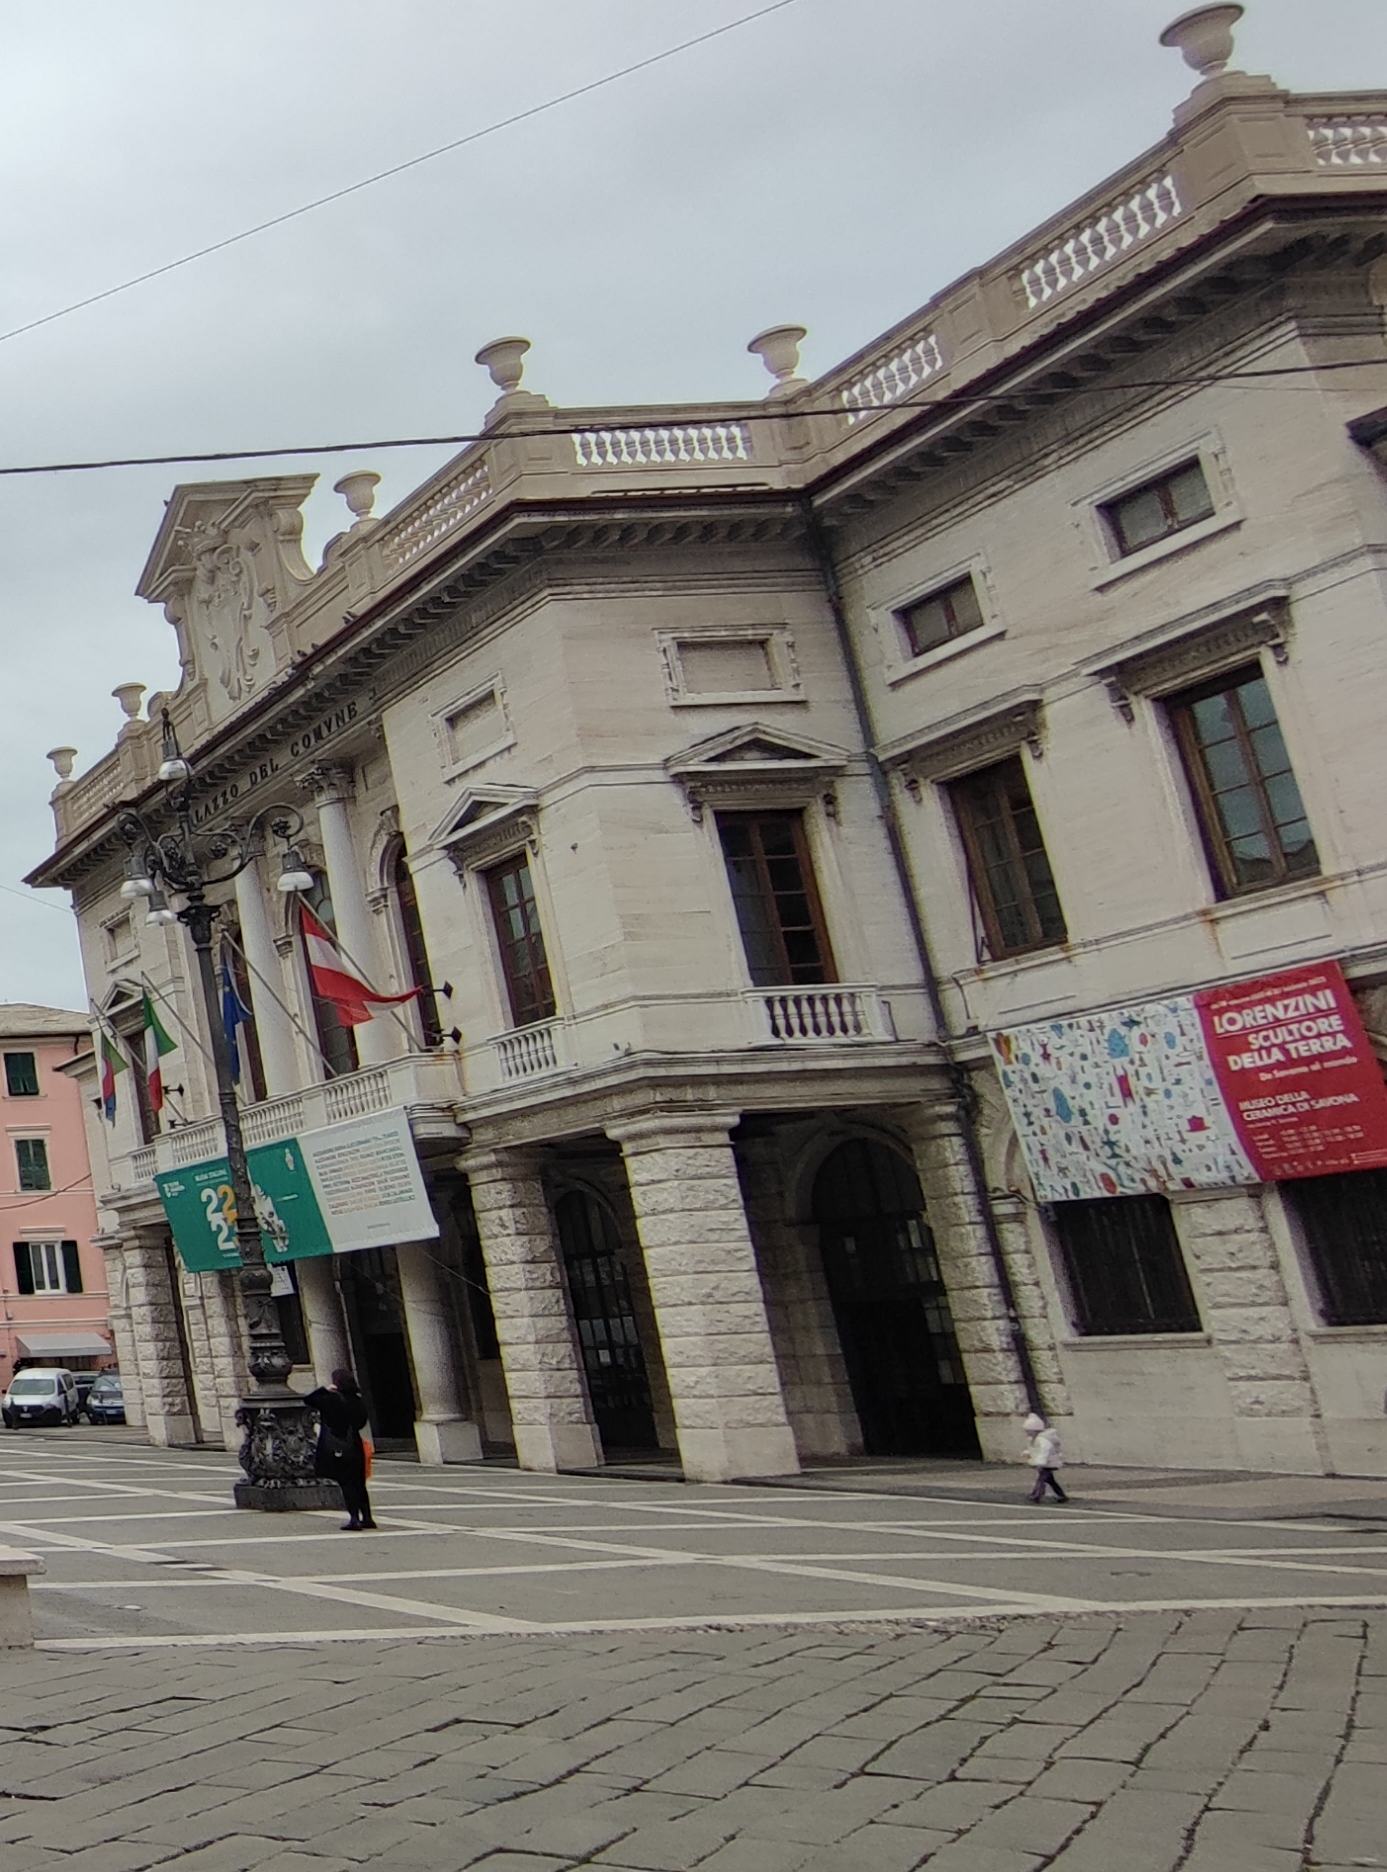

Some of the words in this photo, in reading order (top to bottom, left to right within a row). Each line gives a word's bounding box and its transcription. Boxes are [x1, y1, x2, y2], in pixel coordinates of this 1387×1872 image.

[249, 758, 279, 787] DEL
[1212, 989, 1337, 1034] LORENZINI
[1247, 1014, 1344, 1049] SCULTORE
[1227, 1047, 1286, 1071] DELLA
[1285, 1033, 1353, 1059] TERRA
[1239, 1097, 1275, 1111] MUSEO
[1275, 1090, 1311, 1104] DELLA
[1242, 1104, 1297, 1121] CERAMICA
[1296, 1101, 1311, 1112] DI
[1310, 1093, 1360, 1110] SAVONA
